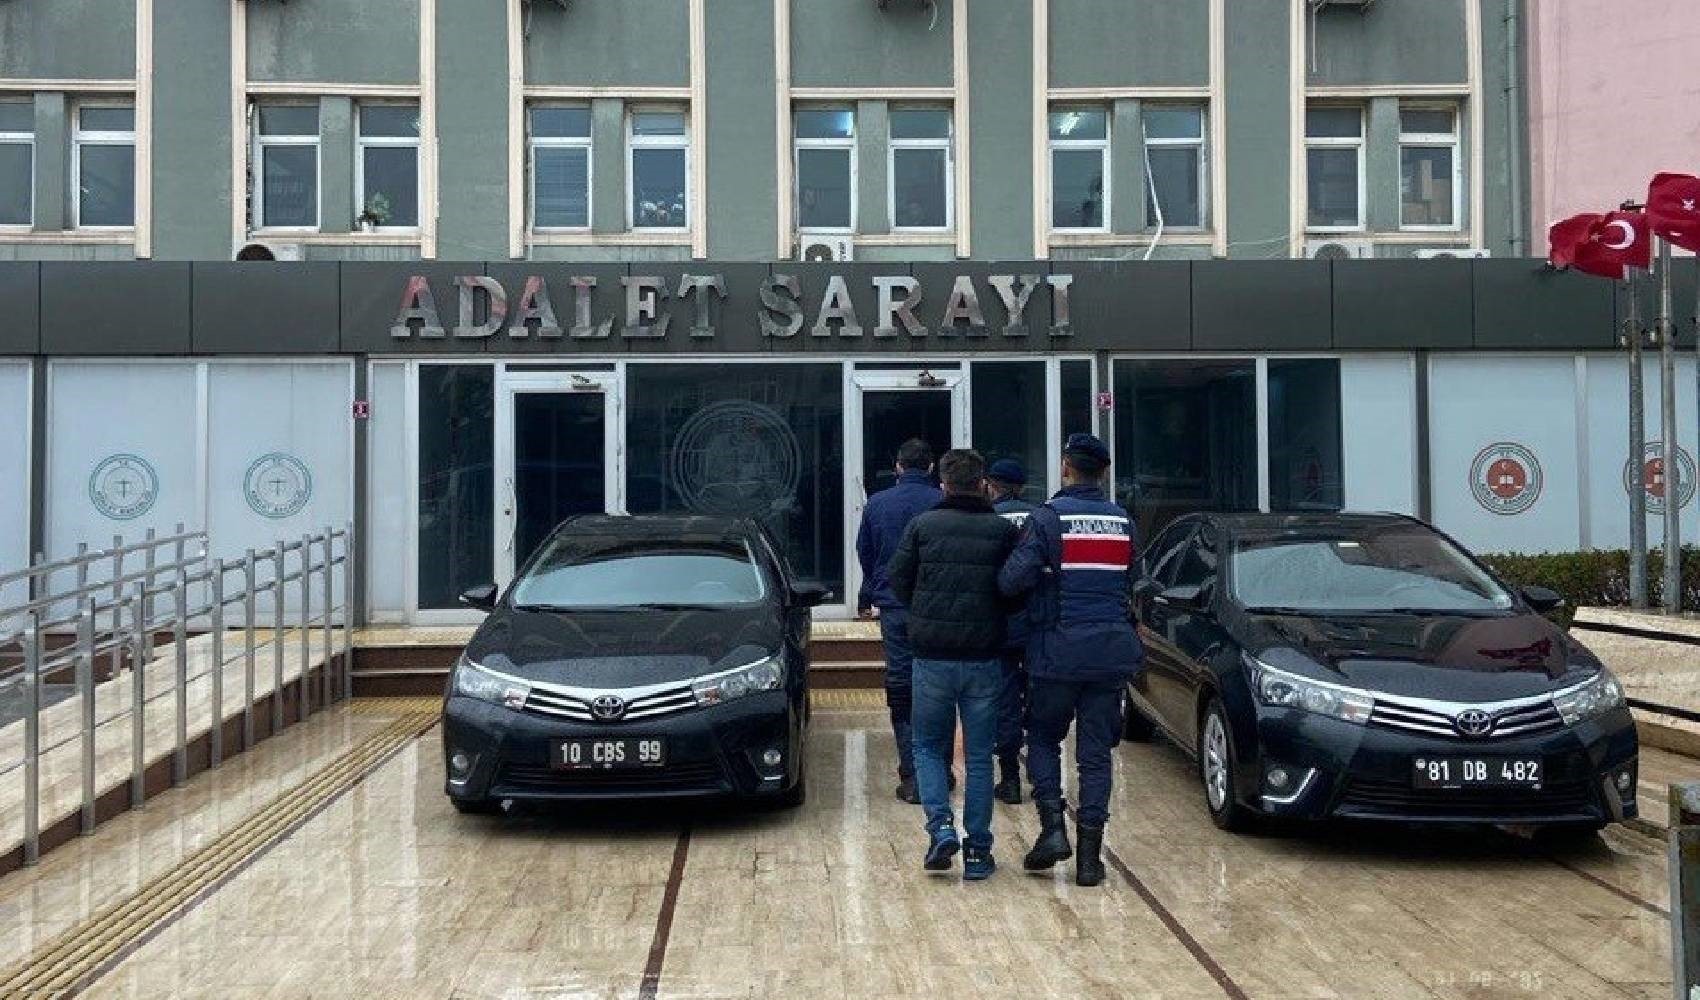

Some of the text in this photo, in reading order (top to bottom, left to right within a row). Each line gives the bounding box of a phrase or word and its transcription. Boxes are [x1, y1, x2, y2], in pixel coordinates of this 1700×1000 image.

[390, 275, 1074, 337] ADALET SARAYI
[561, 741, 661, 763] 10 CBS 99
[1428, 760, 1539, 781] 81 DB 482
